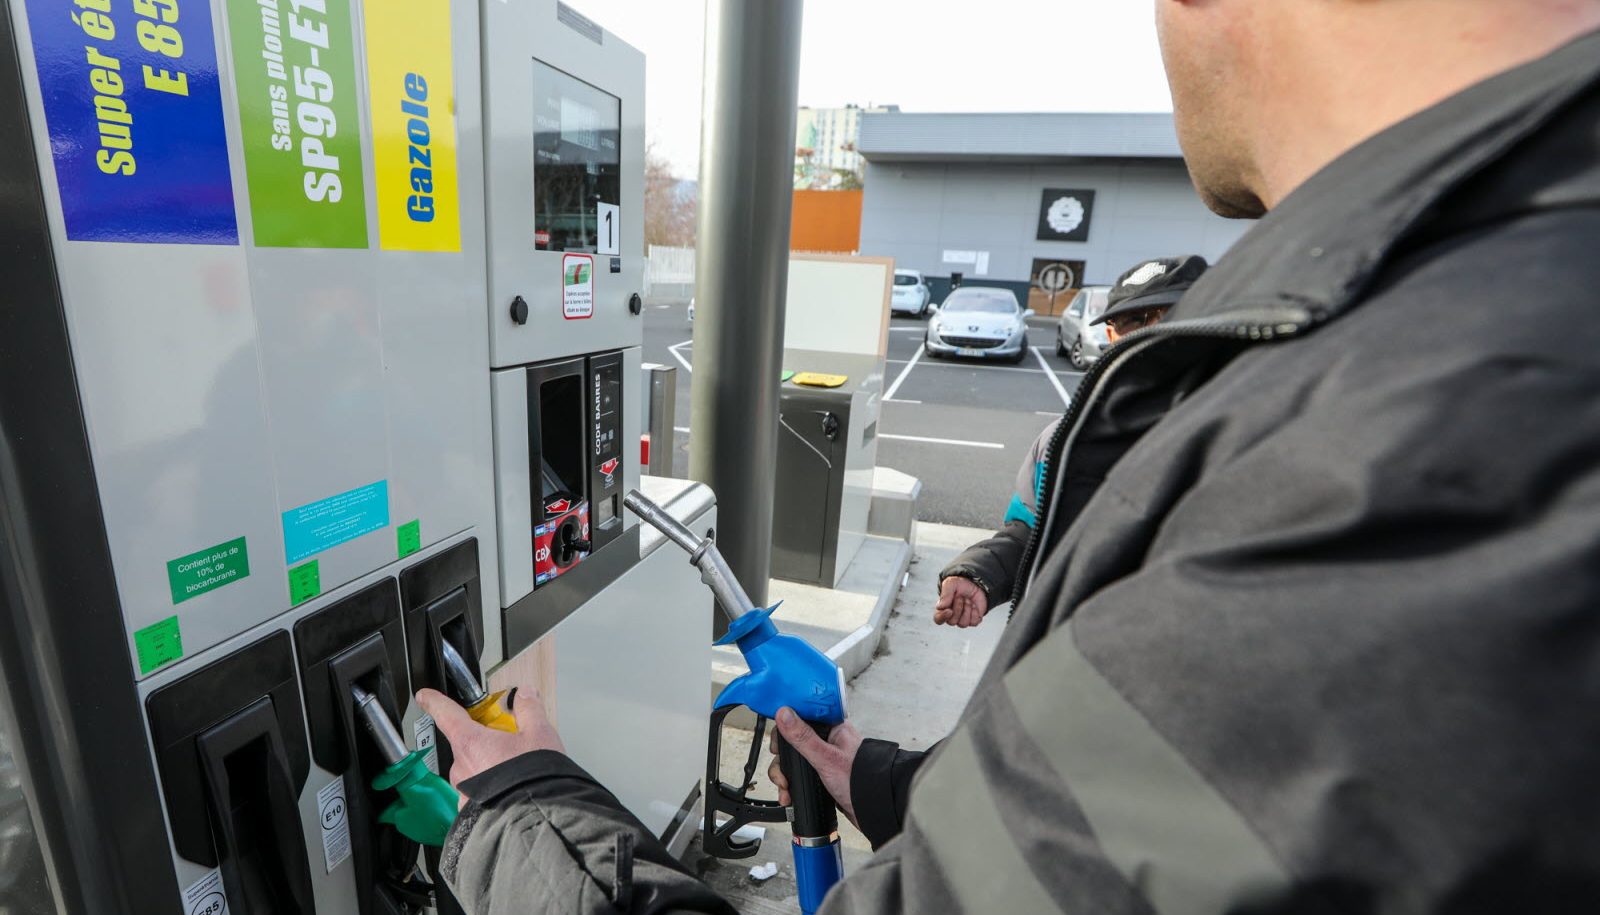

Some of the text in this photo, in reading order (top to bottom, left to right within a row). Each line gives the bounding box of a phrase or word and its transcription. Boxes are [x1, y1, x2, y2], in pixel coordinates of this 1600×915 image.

[133, 0, 189, 96] E 85
[84, 45, 136, 176] Super
[269, 84, 292, 151] Sans
[401, 72, 435, 222] Gazole
[605, 210, 612, 249] 1
[177, 546, 239, 573] Contient plus de
[535, 548, 546, 562] CB
[185, 568, 237, 593] biocarburants
[197, 563, 225, 578] 10% de
[421, 735, 431, 747] B7
[325, 804, 342, 823] E10
